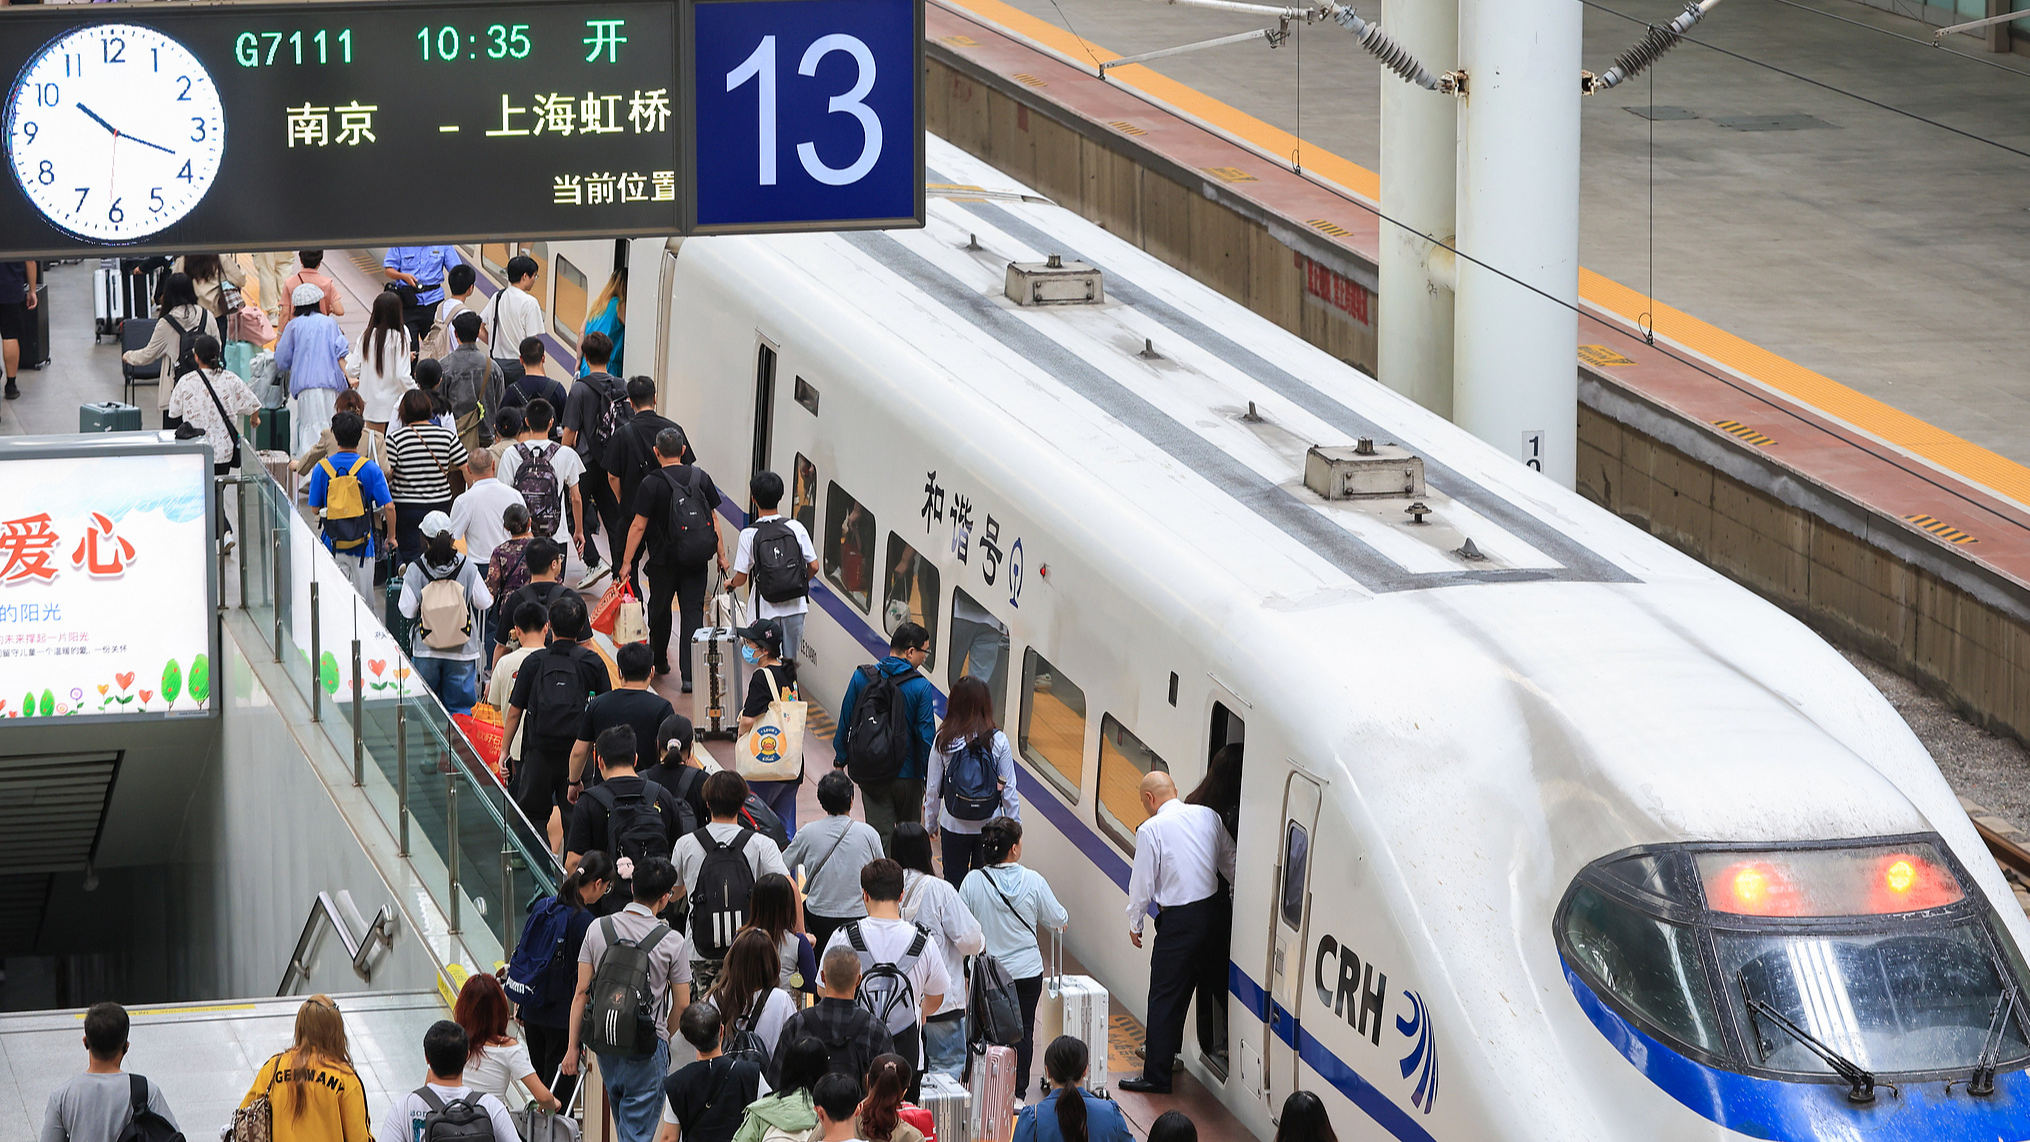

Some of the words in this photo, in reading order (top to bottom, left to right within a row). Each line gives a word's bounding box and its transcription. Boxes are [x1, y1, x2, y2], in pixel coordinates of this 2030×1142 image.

[101, 37, 126, 64] 12
[235, 29, 351, 67] G7111
[417, 24, 531, 61] 10:35
[583, 19, 628, 63] 开
[64, 53, 82, 78] 11
[151, 47, 158, 73] 1
[35, 82, 60, 107] 10
[176, 75, 192, 102] 2
[286, 100, 378, 148] 南京
[485, 88, 672, 137] 上海虹桥
[726, 33, 883, 186] 13
[23, 121, 38, 146] 9
[190, 116, 206, 143] 3
[38, 159, 55, 186] 8
[176, 158, 194, 185] 4
[74, 187, 91, 213] 7
[148, 187, 165, 213] 5
[553, 170, 676, 206] 当前位置
[108, 197, 124, 224] 6
[921, 470, 1004, 587] 和谐号
[0, 512, 136, 581] 爱心
[0, 602, 62, 623] 的阳光
[1315, 934, 1387, 1048] CRH
[275, 1068, 345, 1095] GEMANY
